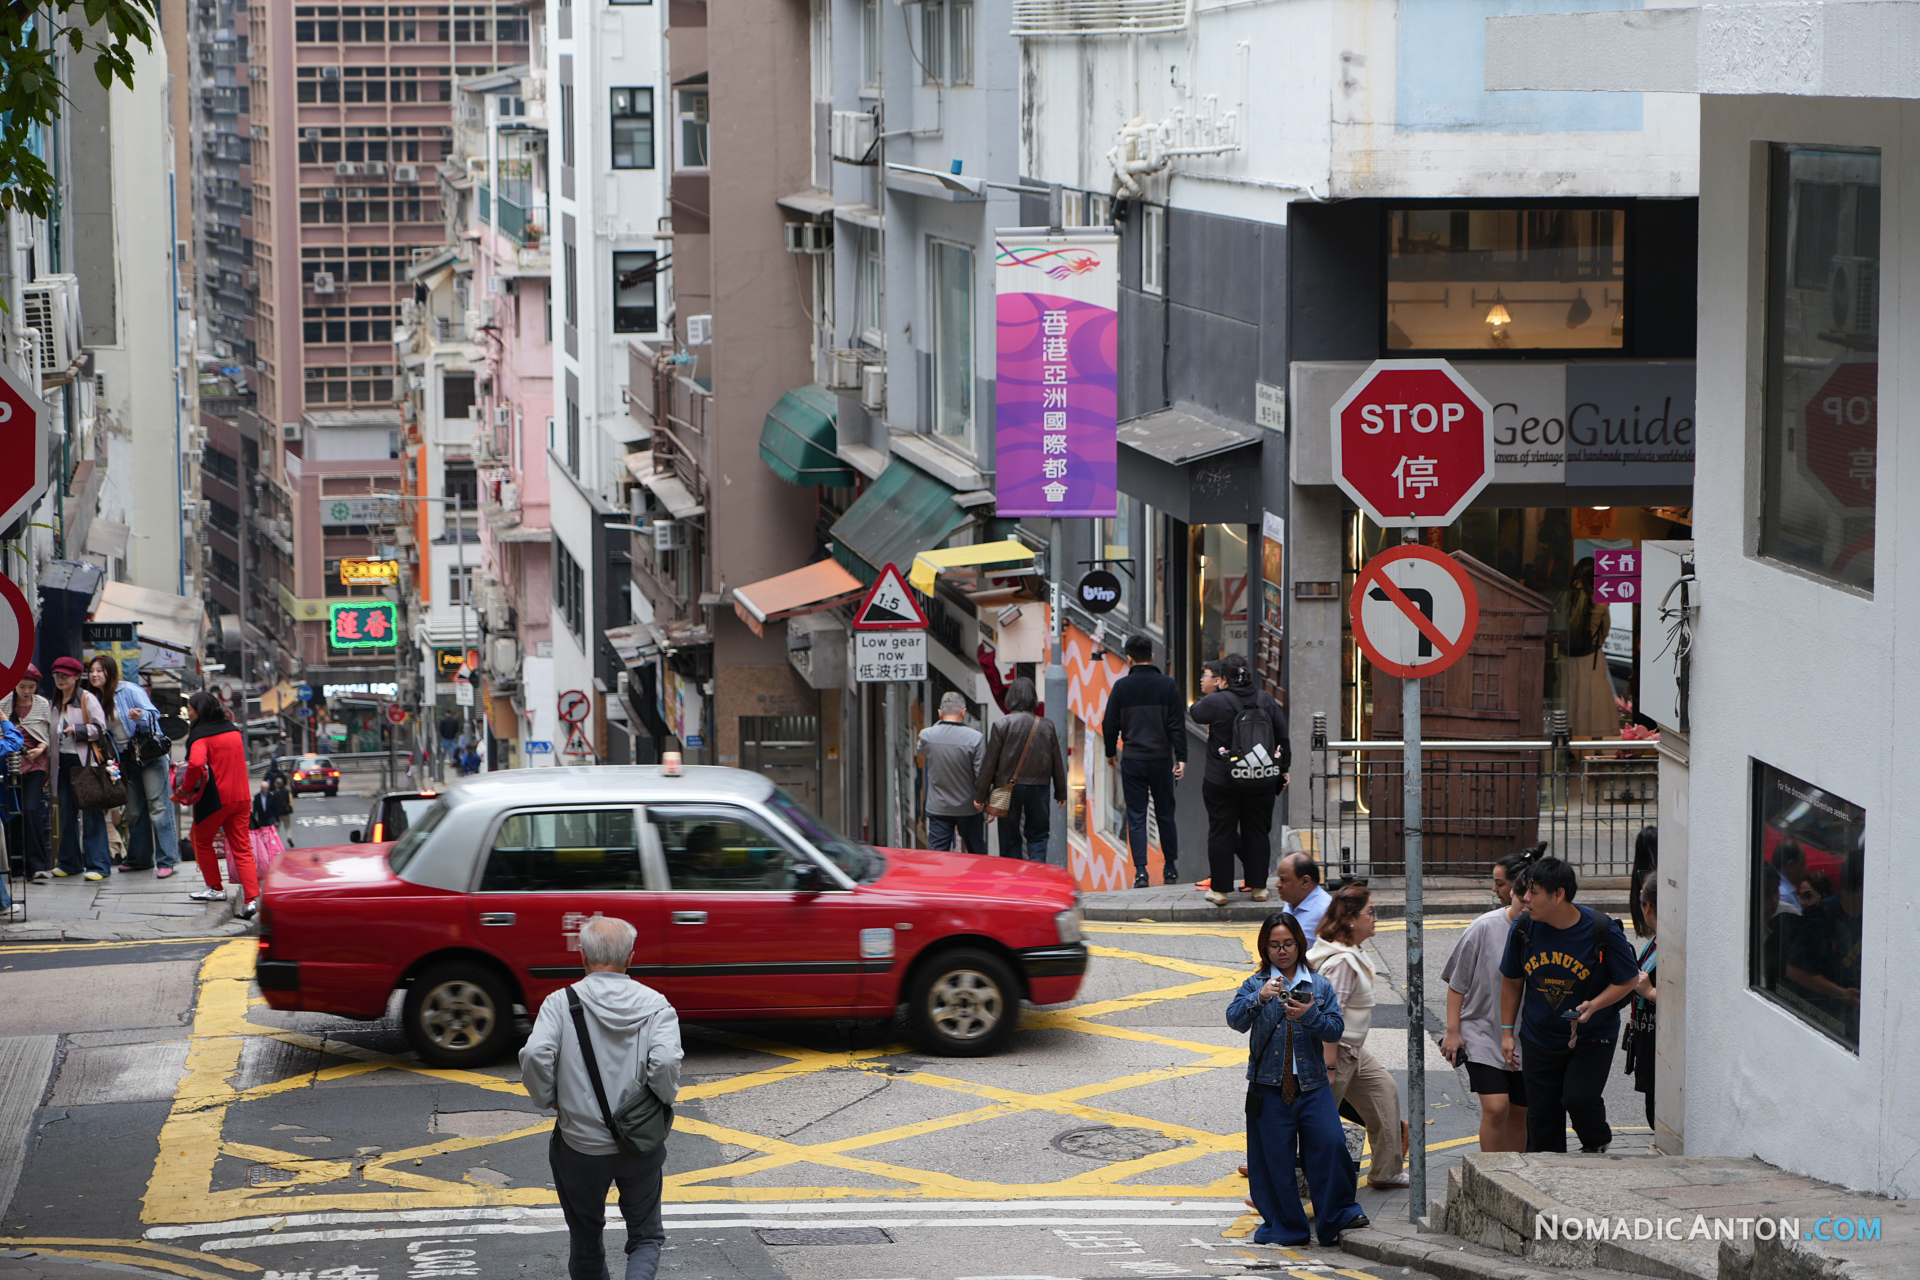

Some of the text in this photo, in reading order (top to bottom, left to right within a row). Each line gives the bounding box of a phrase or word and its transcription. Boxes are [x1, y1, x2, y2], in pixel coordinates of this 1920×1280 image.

[1042, 310, 1068, 502] 香港亞洲國際都會
[1361, 403, 1465, 434] STOP
[1531, 450, 1564, 467] vintage
[1583, 450, 1622, 462] handmade
[1391, 455, 1438, 499] 停
[879, 593, 900, 611] 1:5
[862, 636, 921, 649] Low gear
[878, 651, 905, 661] now
[859, 663, 925, 679] 低波行車
[1231, 765, 1280, 779] adidas
[1524, 951, 1591, 981] PEANUTS
